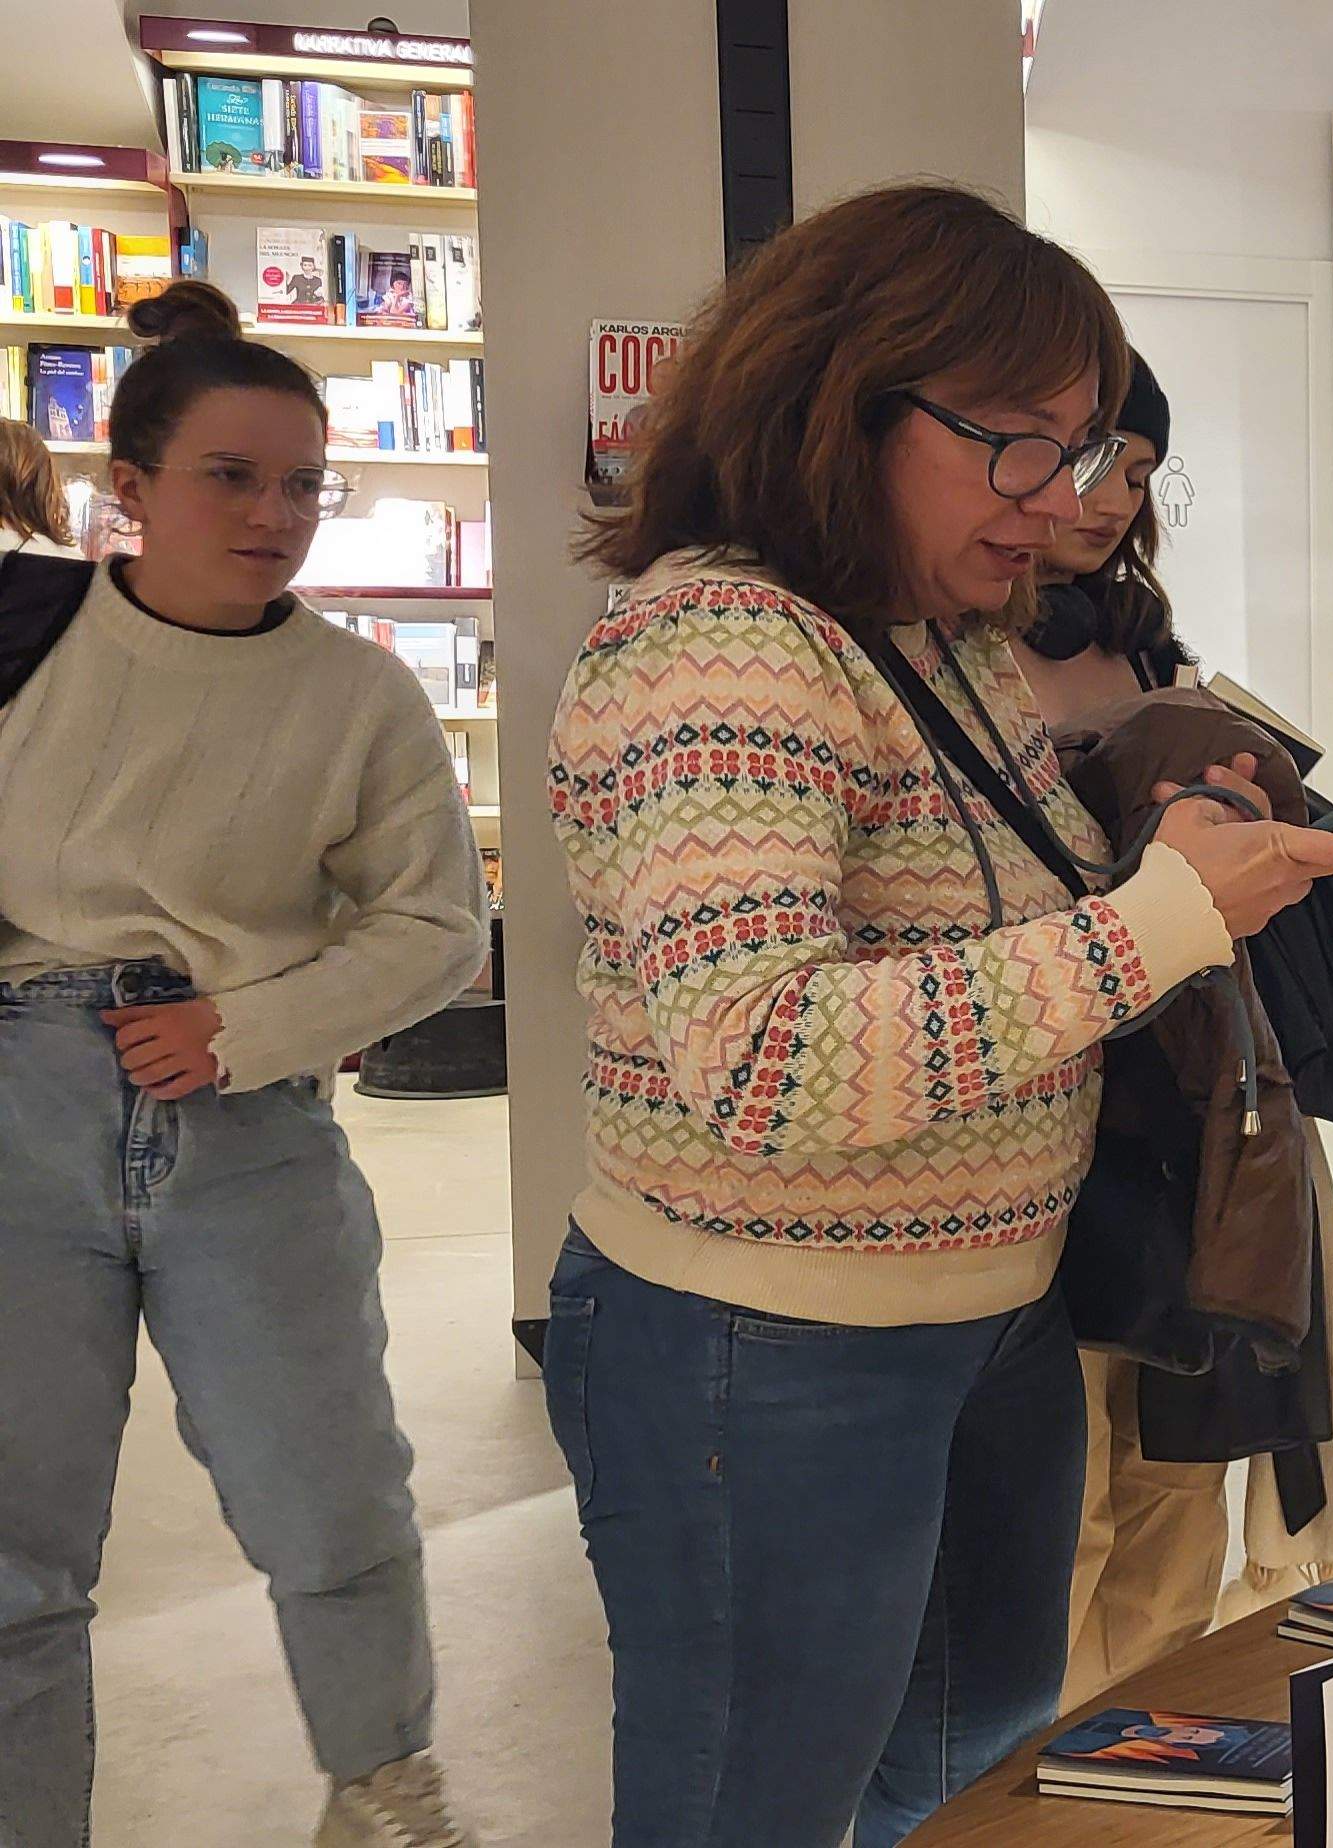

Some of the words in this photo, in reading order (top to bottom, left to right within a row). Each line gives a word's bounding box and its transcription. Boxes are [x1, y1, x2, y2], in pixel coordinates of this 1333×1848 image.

[294, 32, 395, 58] NARRATIVA
[600, 324, 649, 335] KARLOS
[651, 326, 692, 338] ARGU
